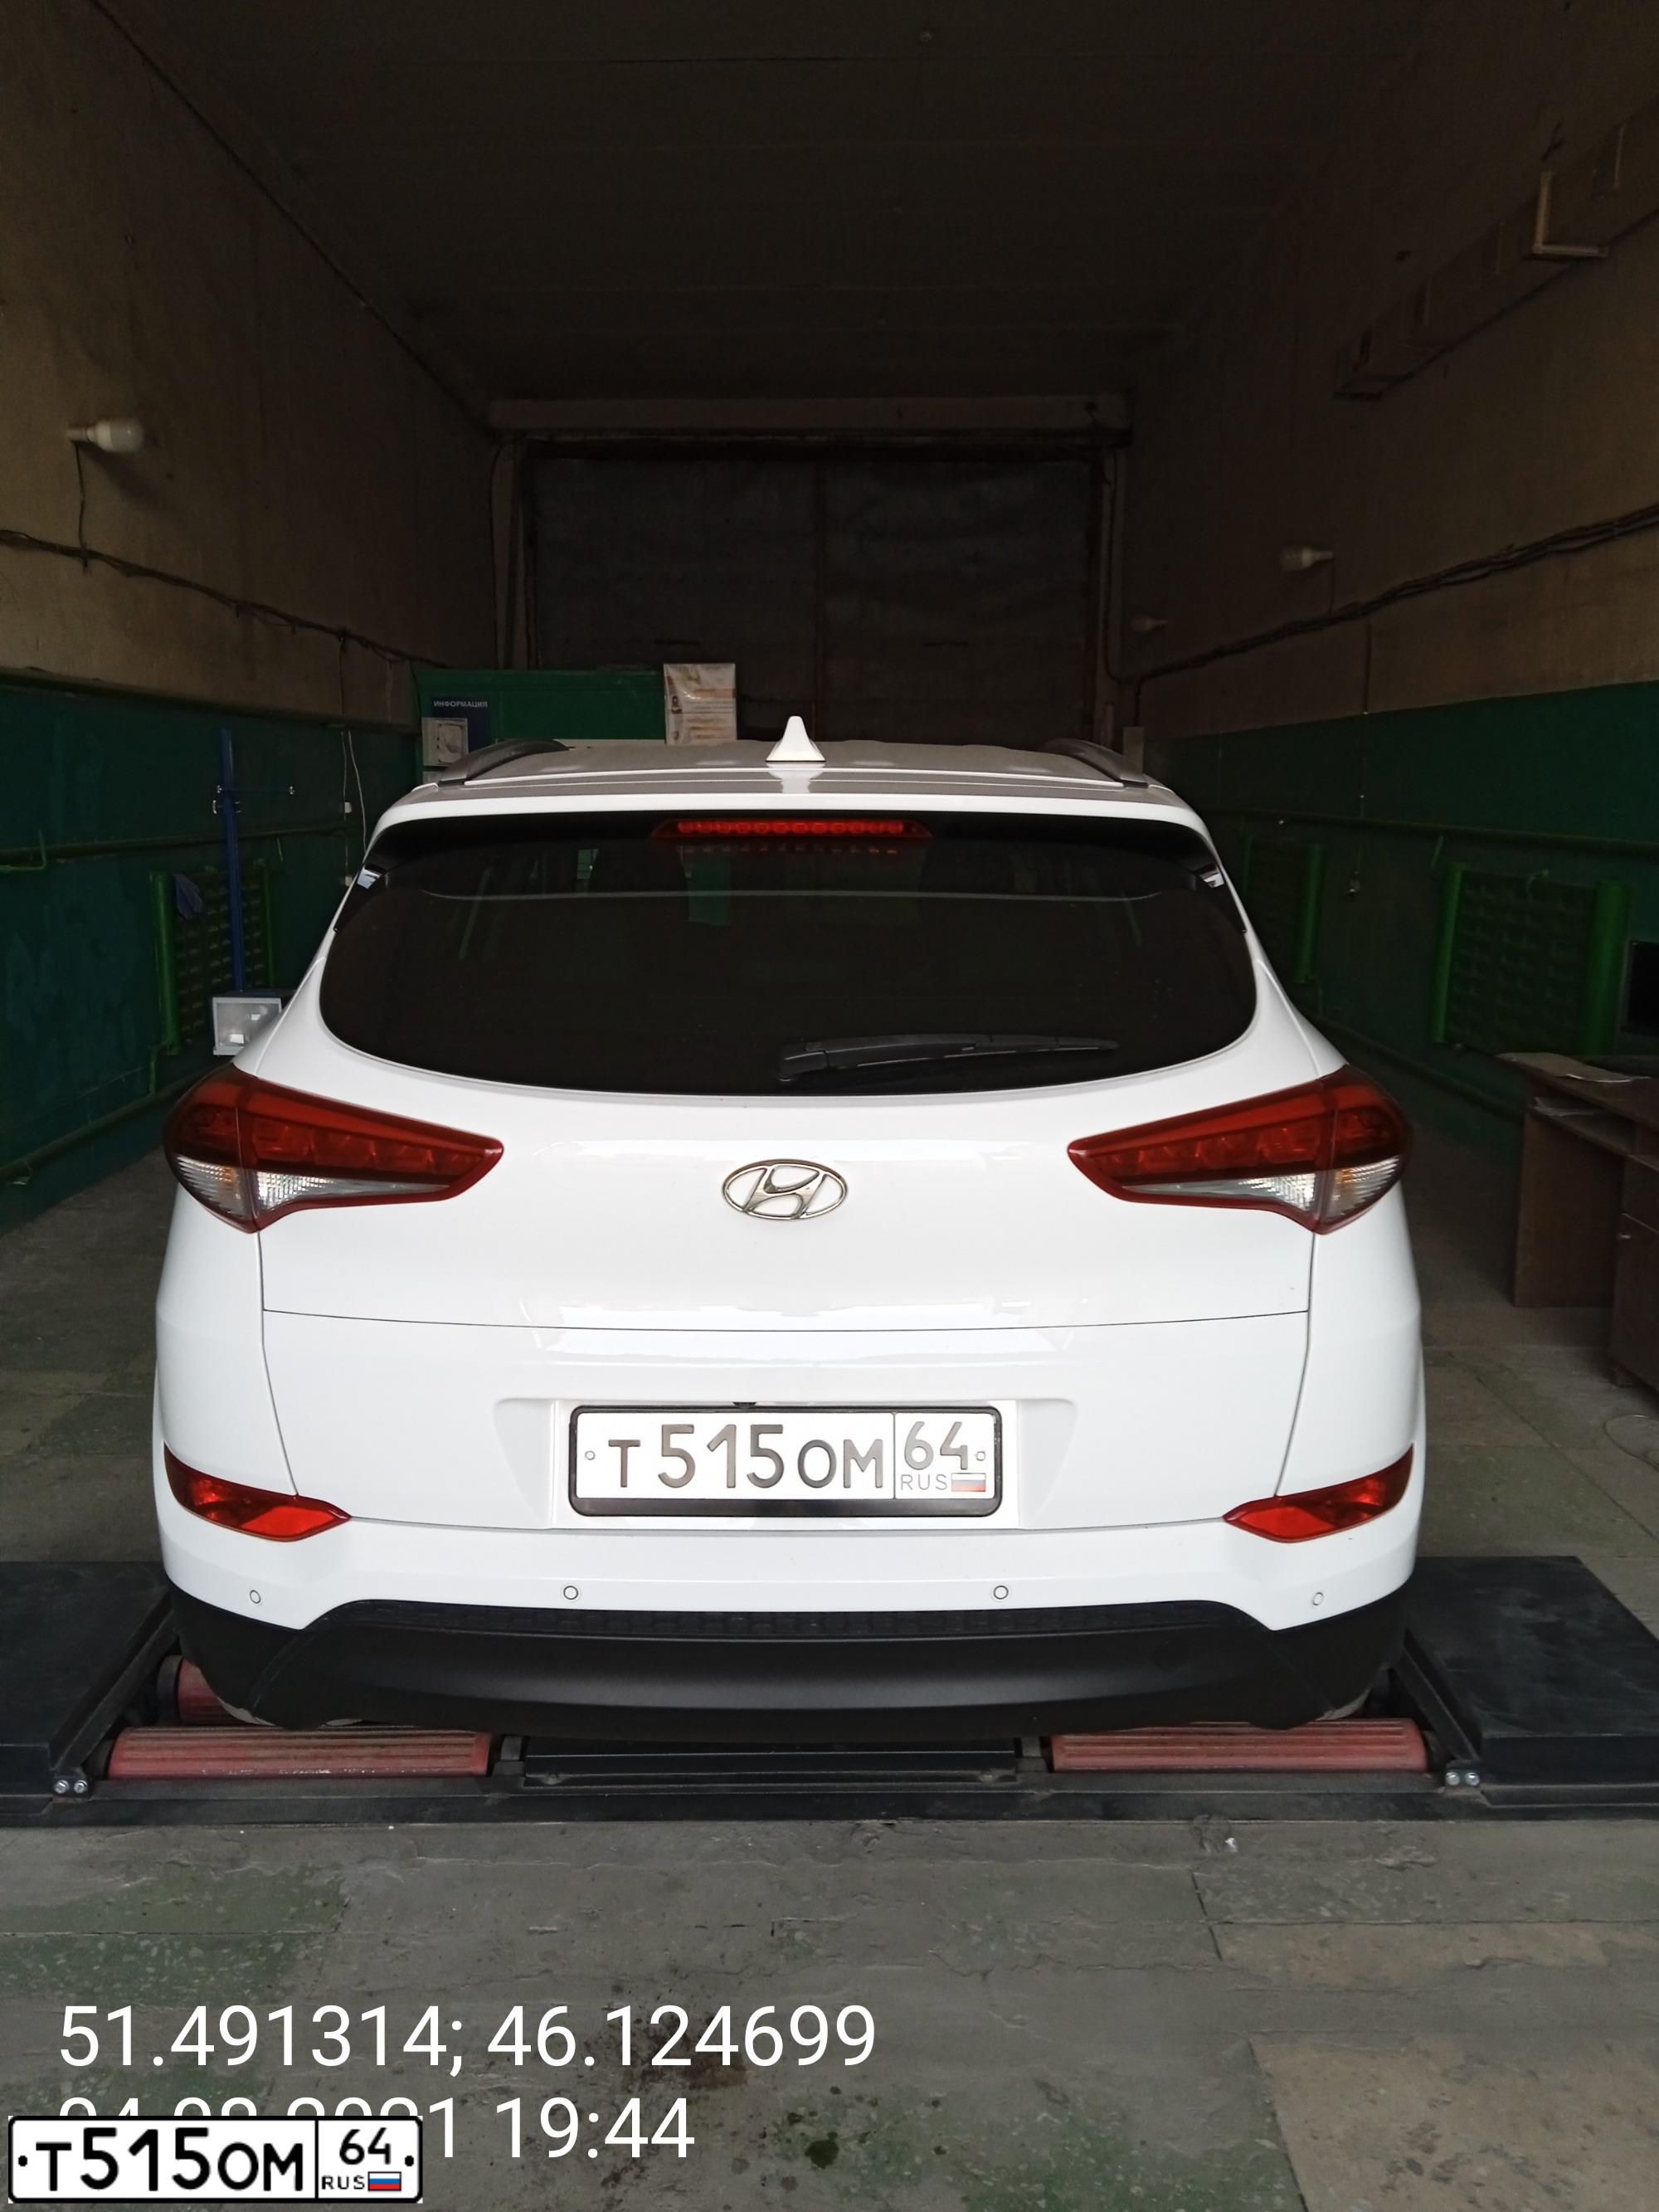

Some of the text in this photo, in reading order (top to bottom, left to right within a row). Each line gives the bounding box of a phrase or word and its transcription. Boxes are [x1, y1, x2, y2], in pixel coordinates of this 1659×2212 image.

[608, 1424, 883, 1488] Т515ОМ
[904, 1420, 968, 1470] 64
[901, 1474, 947, 1491] RUS
